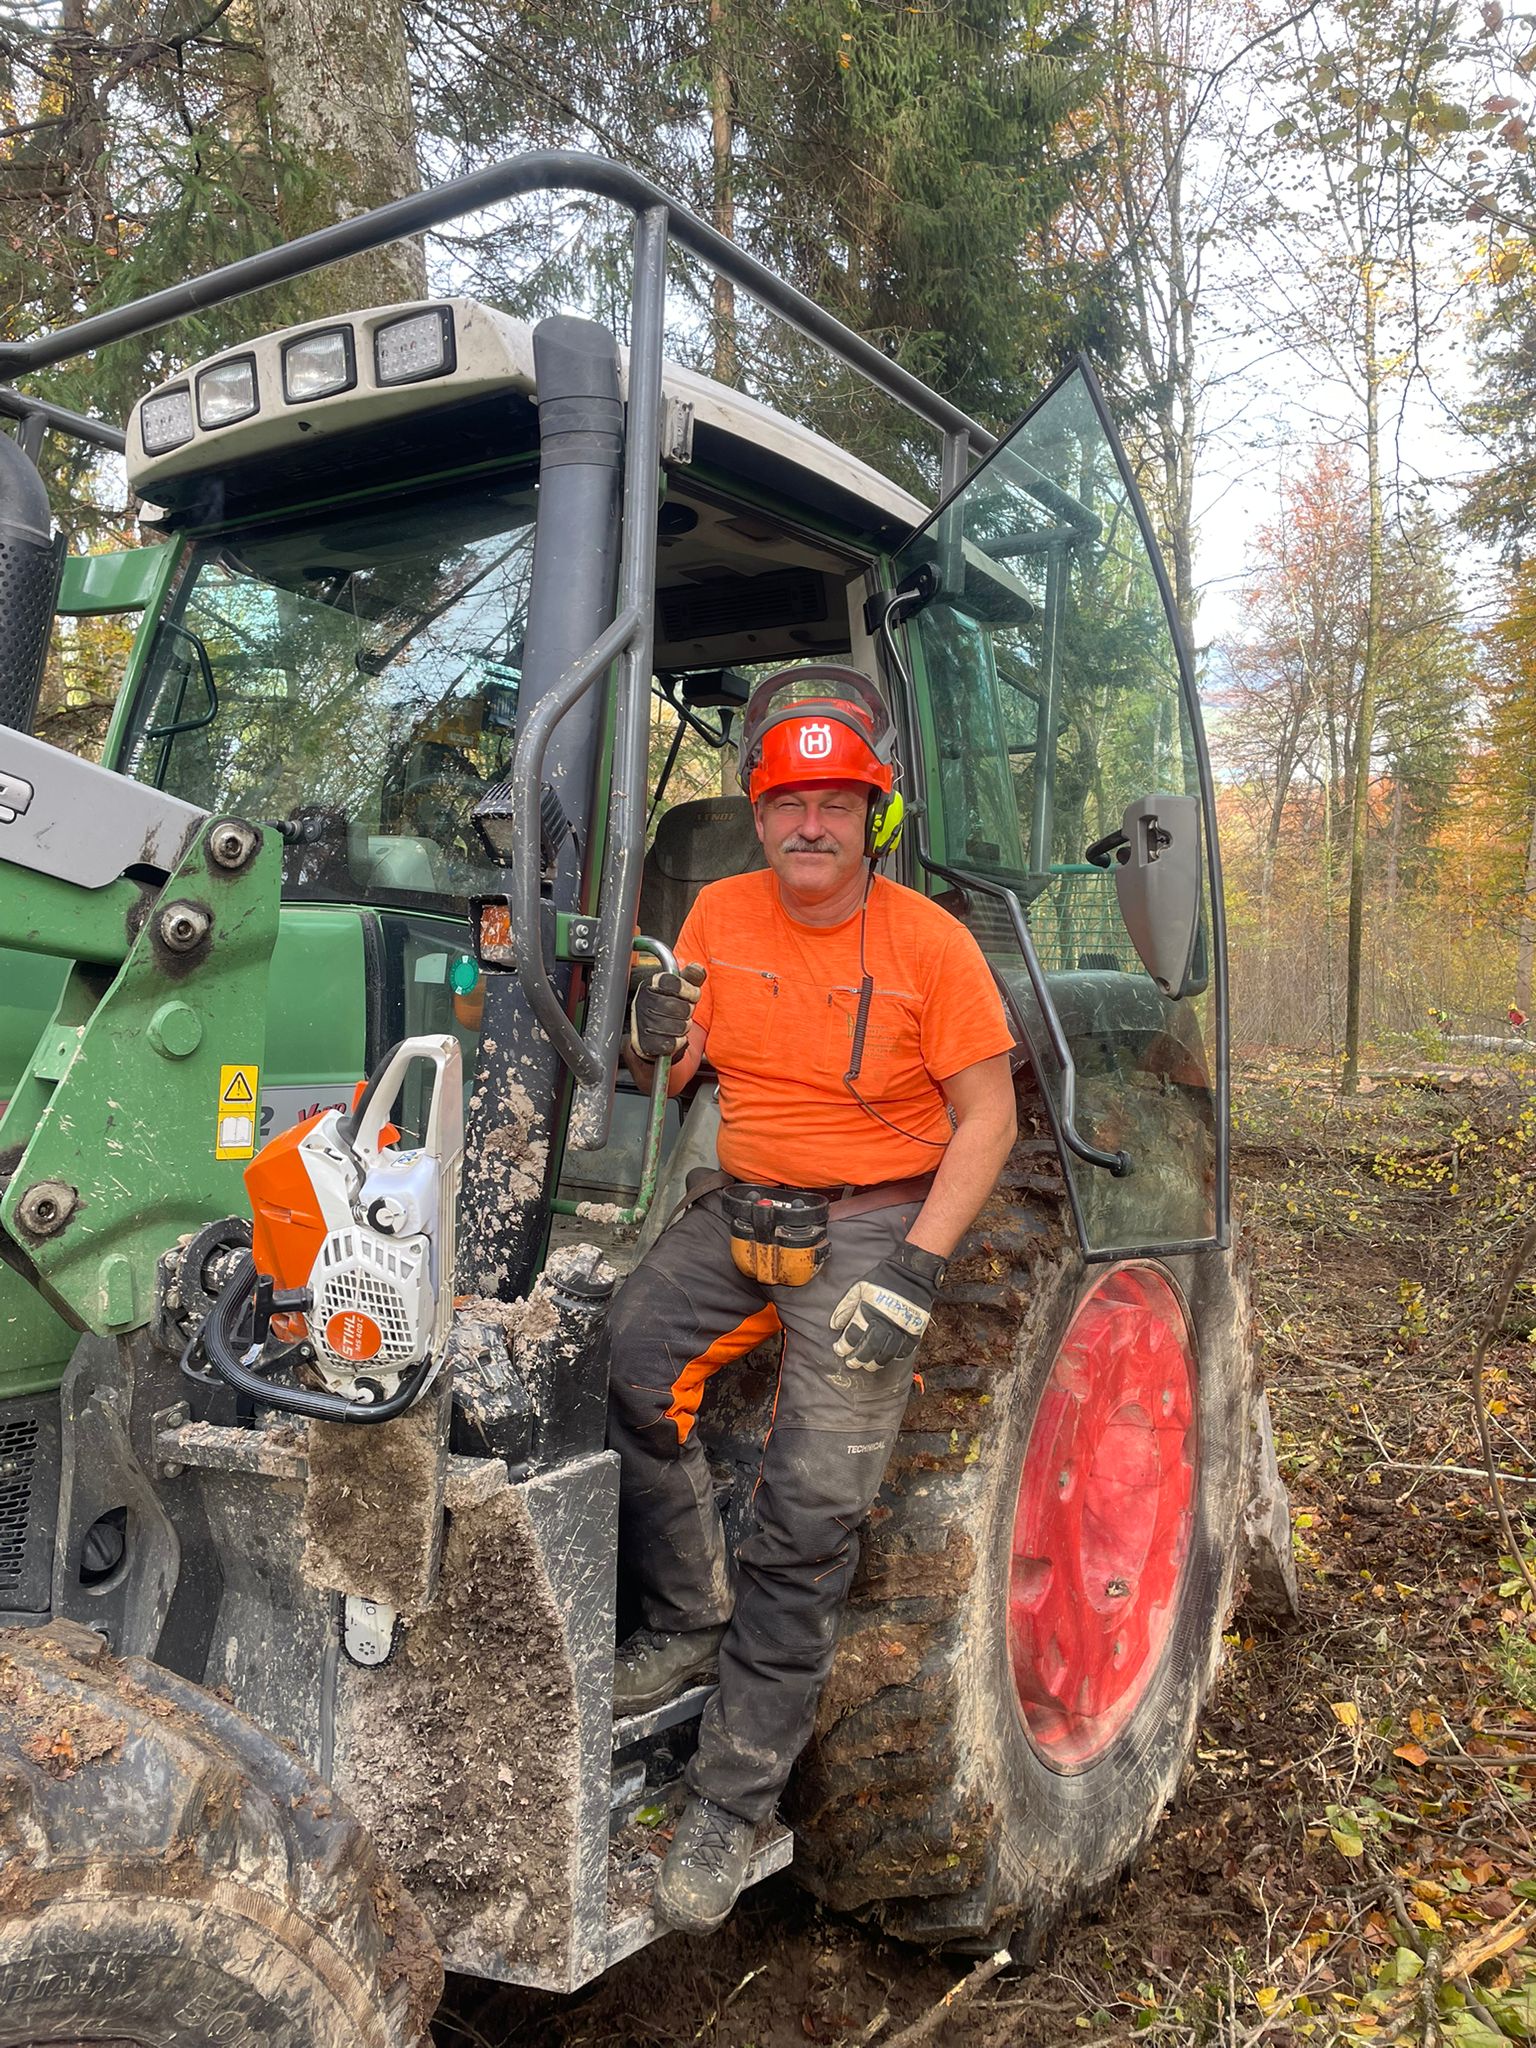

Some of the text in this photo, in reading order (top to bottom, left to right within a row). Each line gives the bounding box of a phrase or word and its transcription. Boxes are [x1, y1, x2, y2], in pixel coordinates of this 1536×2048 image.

[342, 1314, 356, 1357] STIHL
[355, 1322, 363, 1339] 400
[354, 1340, 363, 1353] MS
